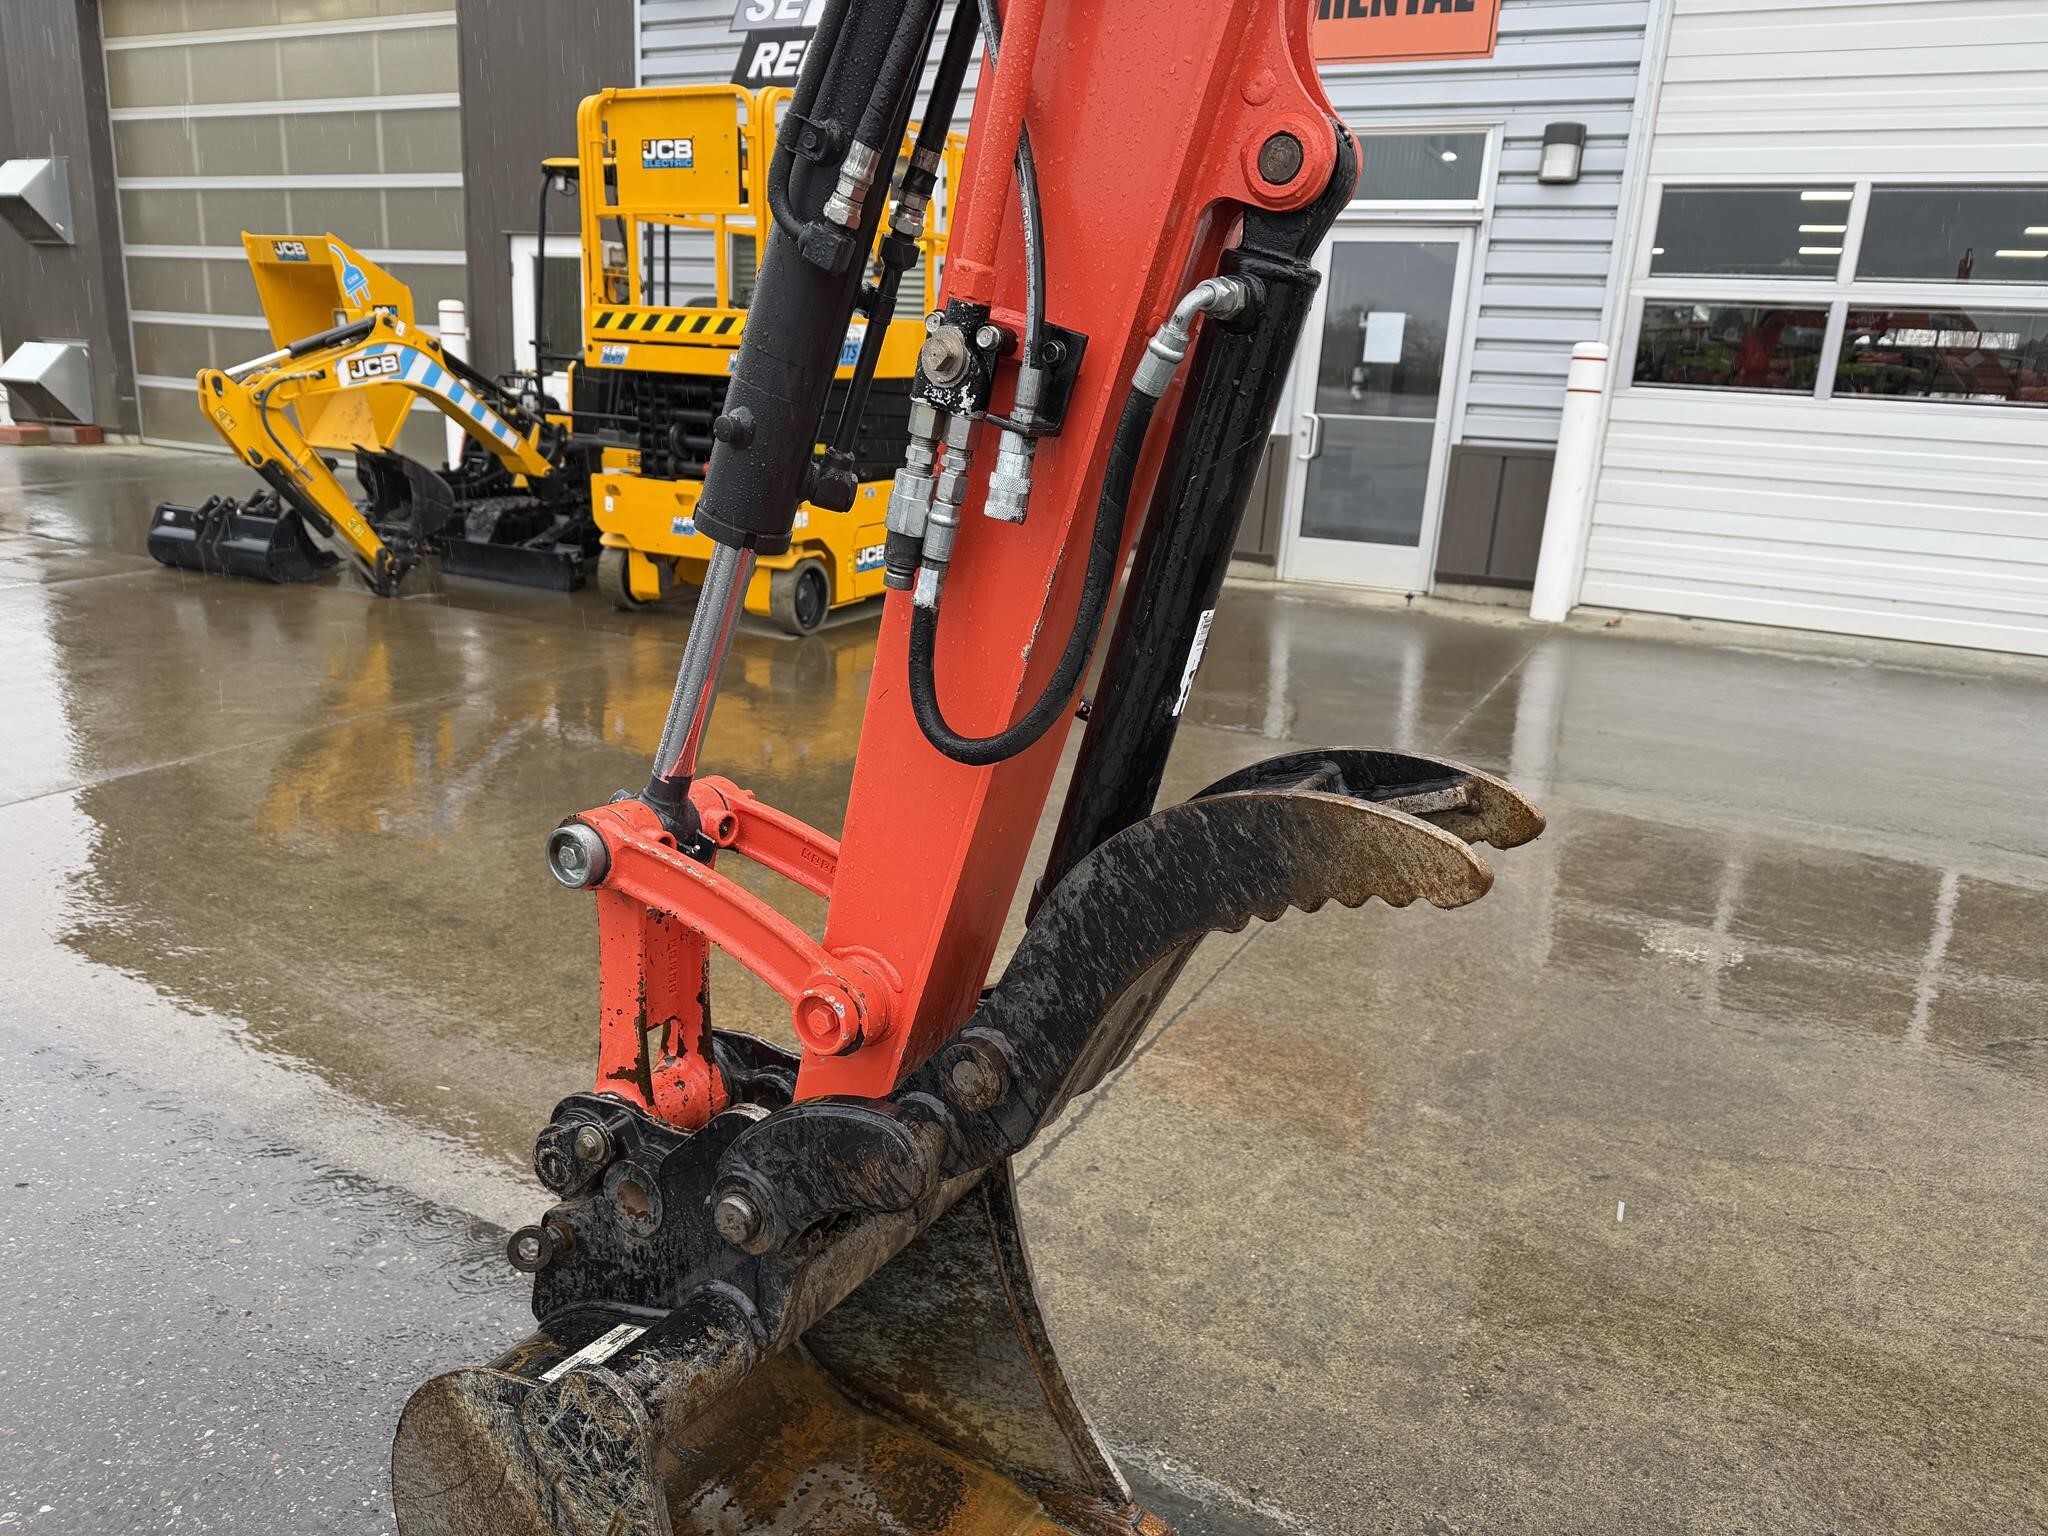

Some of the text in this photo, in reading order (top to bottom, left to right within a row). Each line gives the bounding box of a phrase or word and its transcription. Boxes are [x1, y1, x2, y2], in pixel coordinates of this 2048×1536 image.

[747, 40, 812, 77] RE
[643, 140, 692, 159] JCB
[274, 242, 307, 255] JCB
[350, 355, 399, 378] JCB
